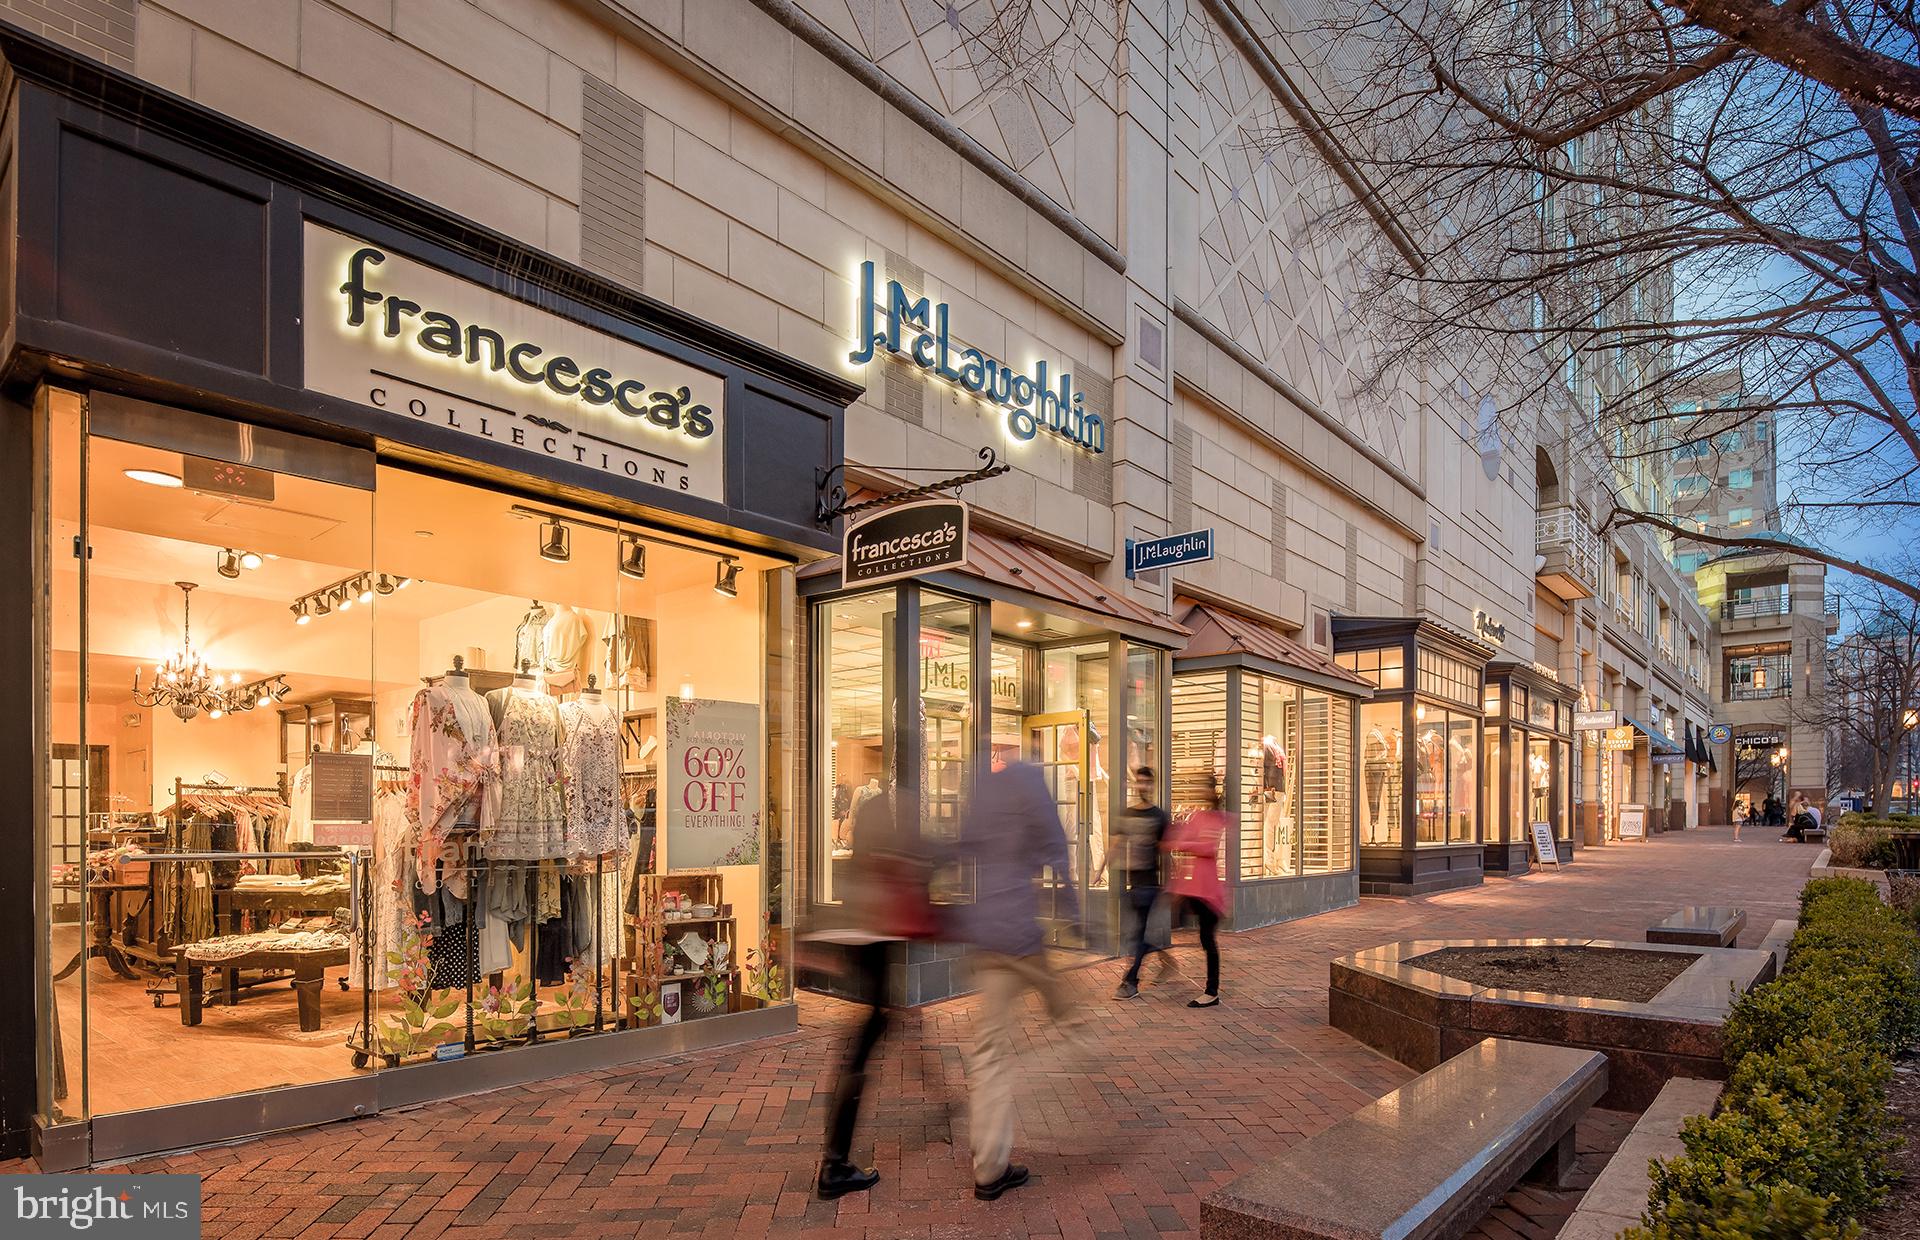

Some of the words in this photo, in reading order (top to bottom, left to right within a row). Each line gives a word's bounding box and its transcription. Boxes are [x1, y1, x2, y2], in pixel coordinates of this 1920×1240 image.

[339, 247, 714, 439] francesca's
[369, 388, 690, 491] COLLECTIONS
[852, 522, 957, 561] francesca's
[1137, 536, 1206, 566] J.McLaughlin
[857, 551, 950, 576] COLLECTIONS
[1735, 736, 1779, 745] CHICO'S
[683, 746, 745, 779] 60%
[683, 780, 746, 813] OFF
[685, 815, 745, 828] EVERYTHING!
